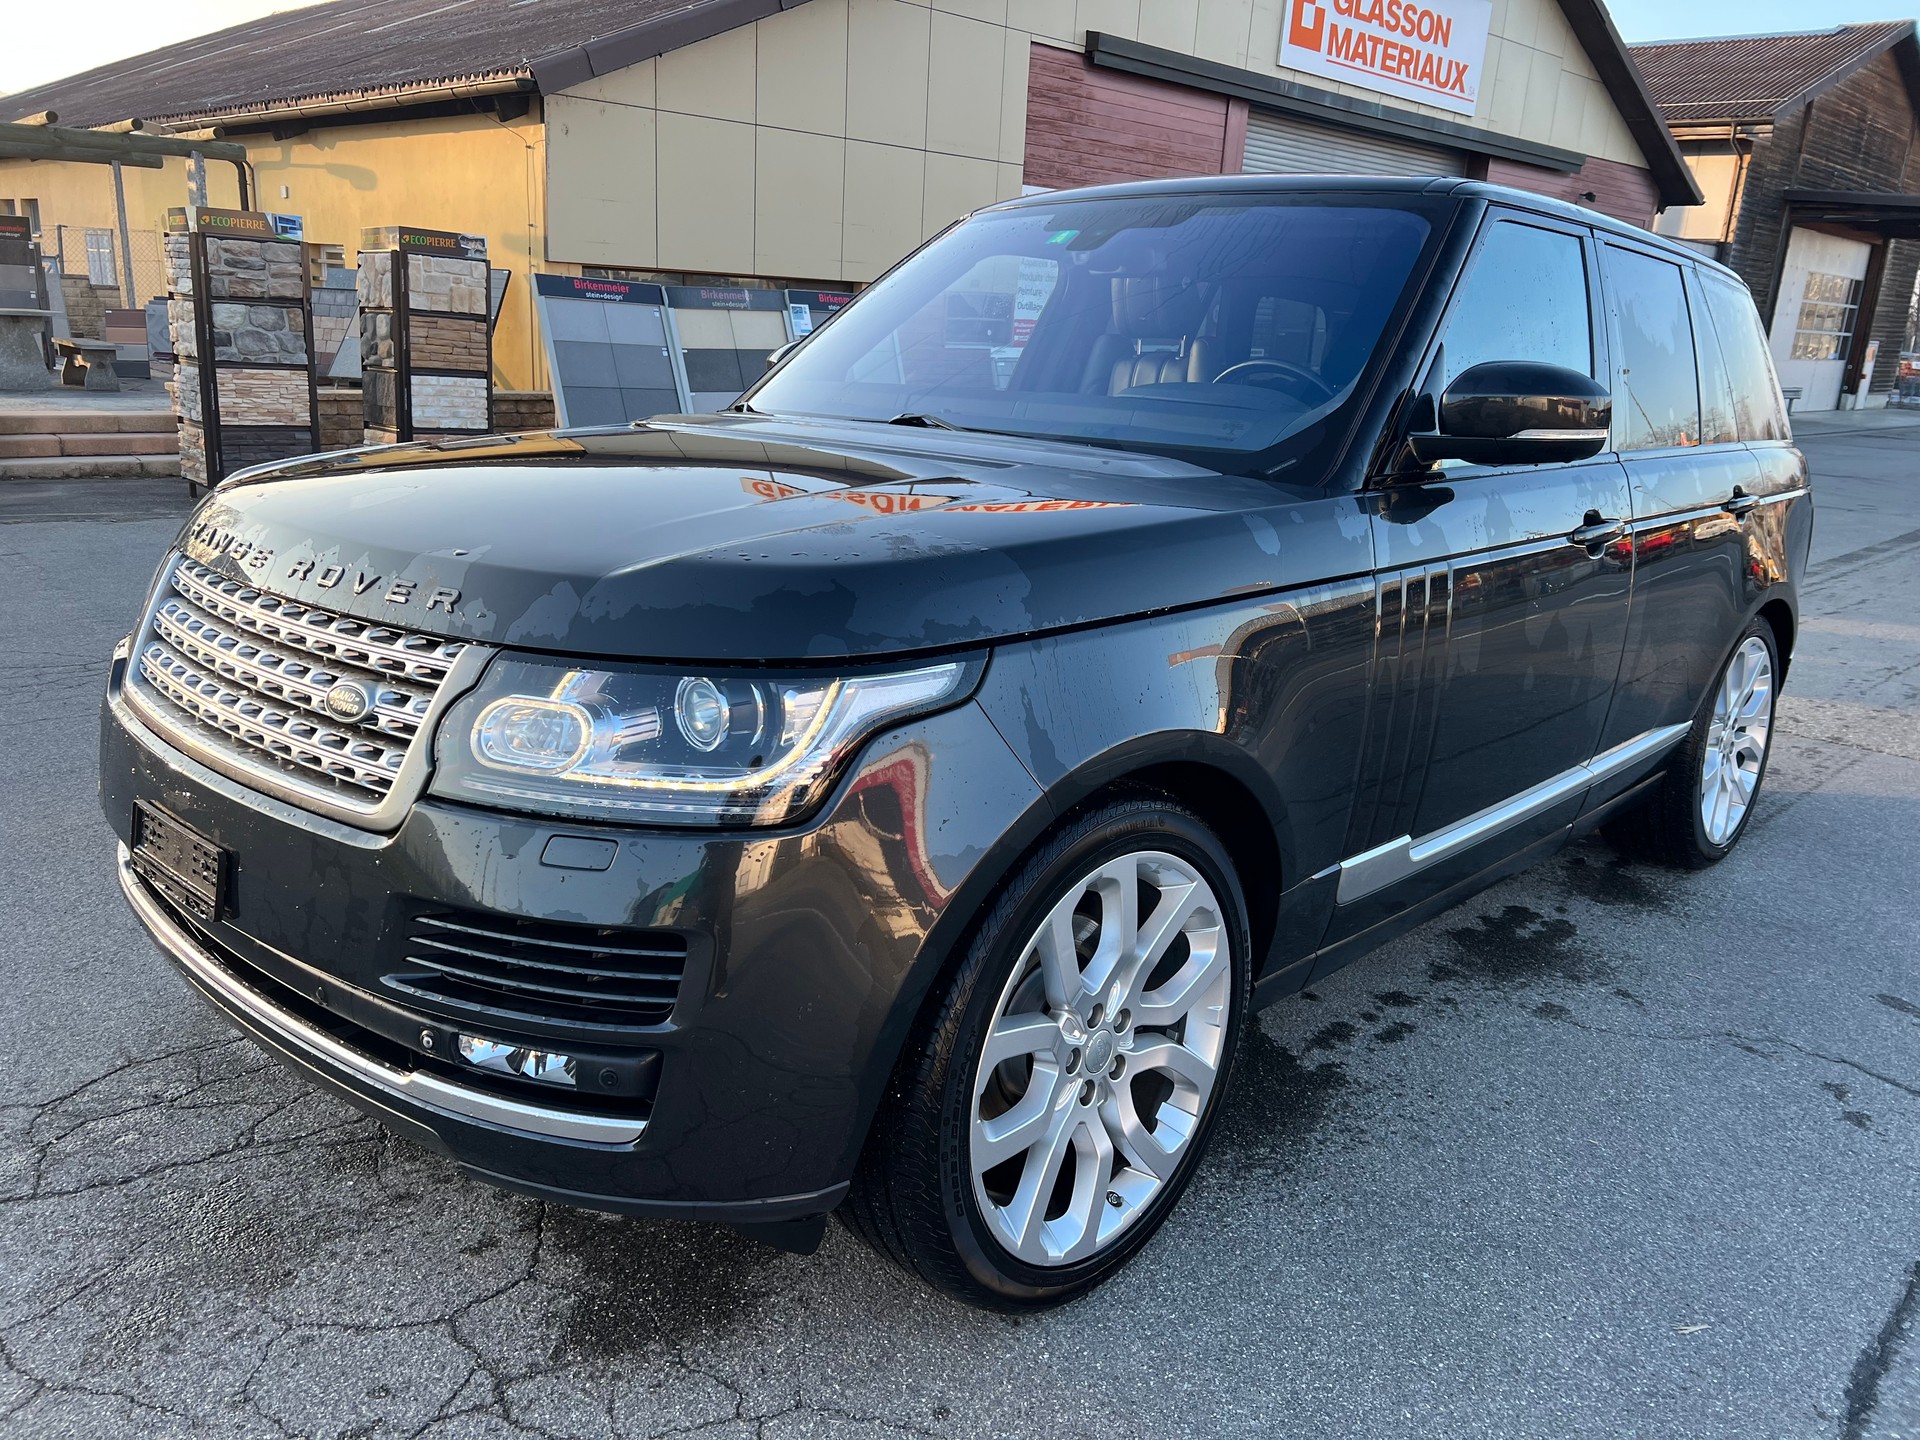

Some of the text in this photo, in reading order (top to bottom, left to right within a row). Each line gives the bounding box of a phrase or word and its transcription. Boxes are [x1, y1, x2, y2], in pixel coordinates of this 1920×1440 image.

[1333, 0, 1452, 48] GLASSON
[1326, 22, 1469, 93] MATERIAUX
[211, 215, 266, 231] ECOPIERRE
[410, 234, 457, 248] ECOPIERRE
[573, 279, 630, 293] Birkenmeier
[818, 293, 849, 304] Birkenm
[287, 557, 462, 614] ROVER
